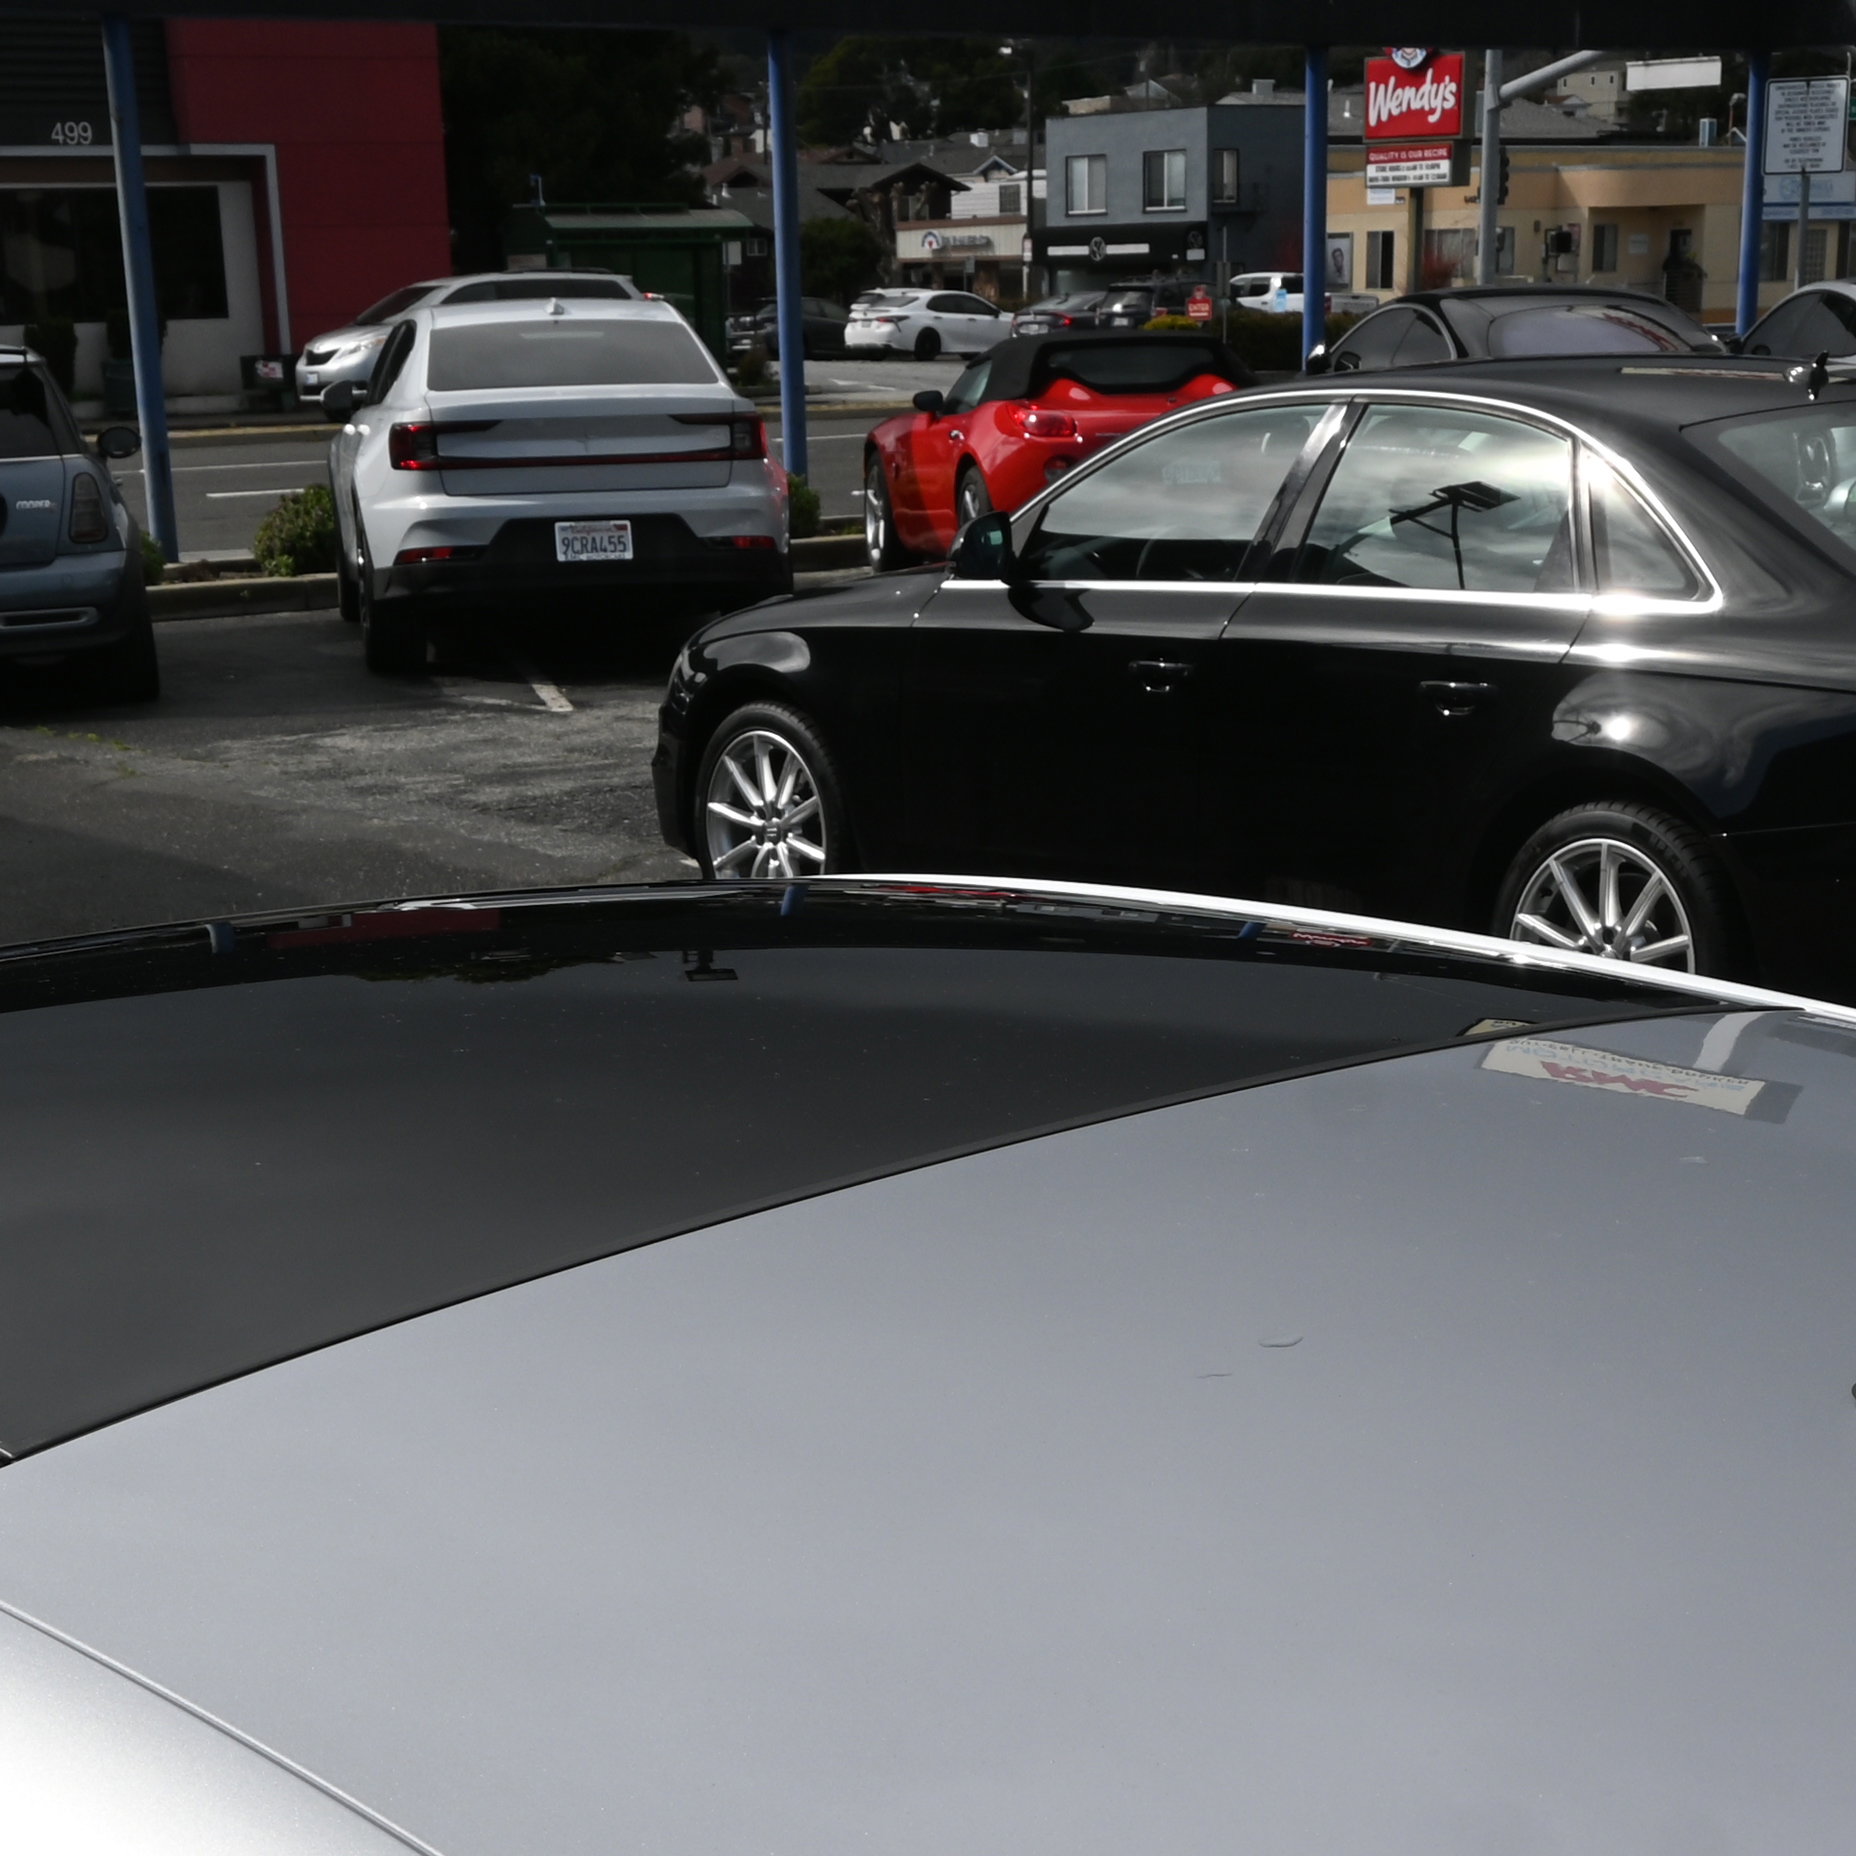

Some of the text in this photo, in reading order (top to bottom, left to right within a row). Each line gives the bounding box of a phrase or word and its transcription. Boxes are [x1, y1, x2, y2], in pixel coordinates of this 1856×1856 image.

[1368, 68, 1457, 127] Wendy's
[51, 121, 92, 144] 499
[562, 535, 627, 555] 9CRA455
